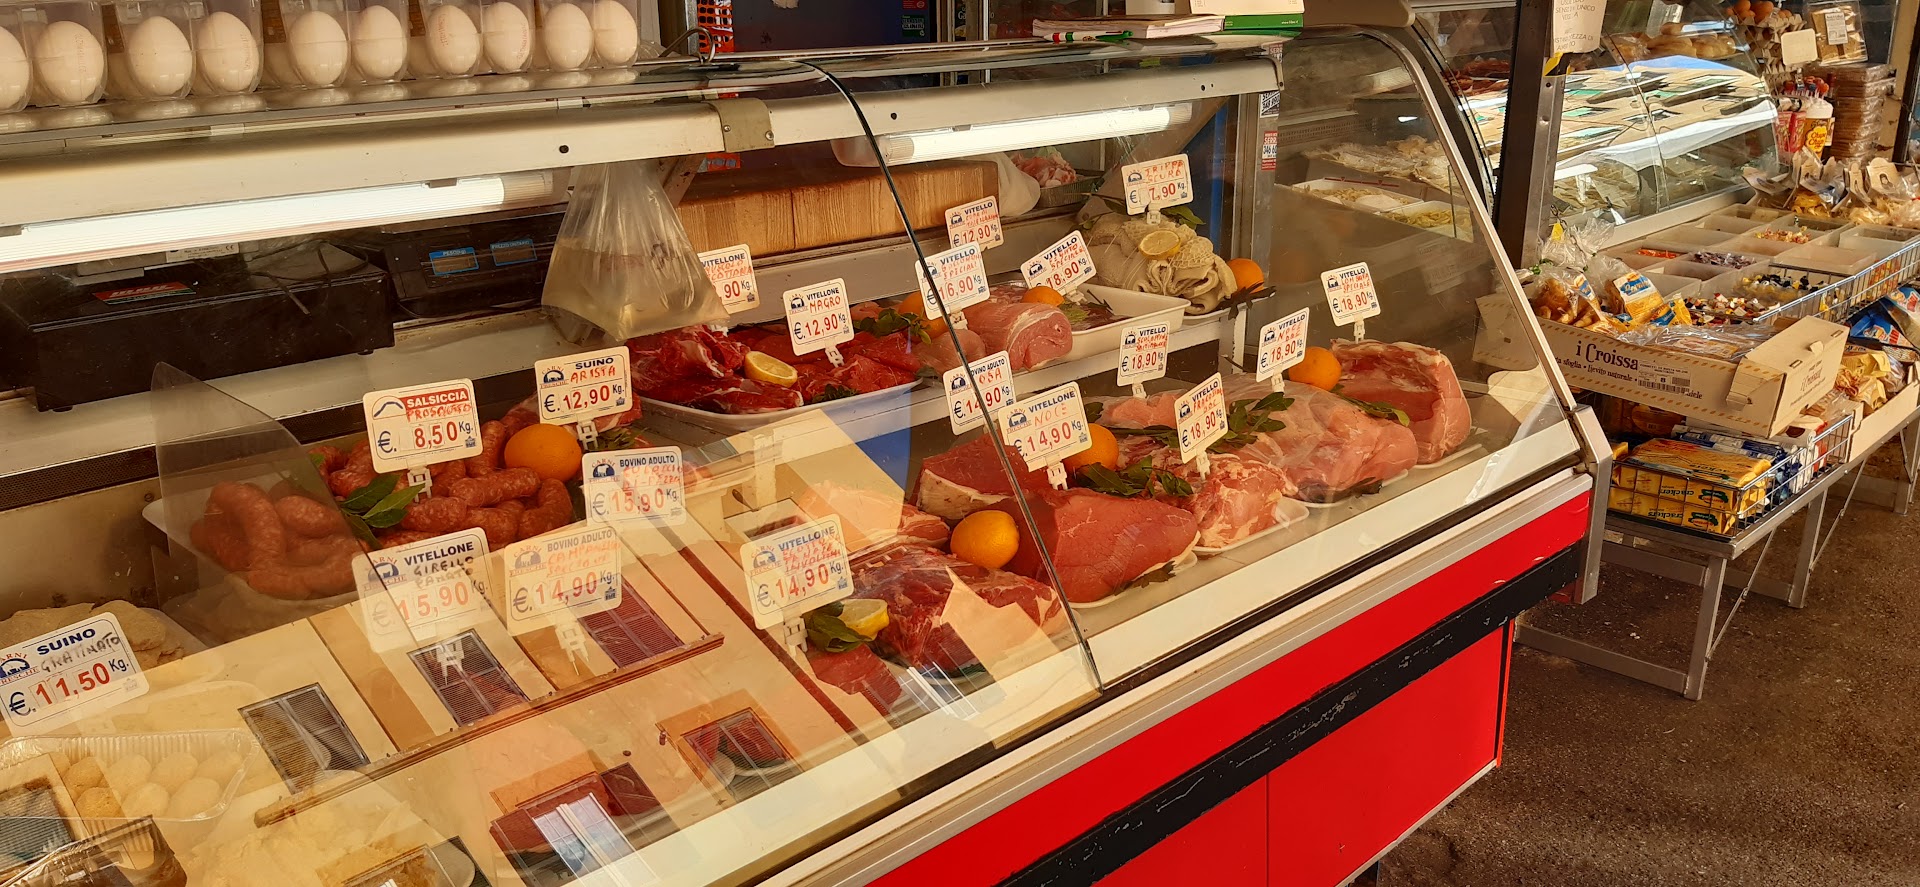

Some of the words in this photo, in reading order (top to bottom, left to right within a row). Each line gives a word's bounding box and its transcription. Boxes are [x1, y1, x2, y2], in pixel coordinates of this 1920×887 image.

[964, 201, 993, 215] VITELLO
[701, 253, 746, 268] VITELLONE
[940, 248, 976, 265] VITELLO
[1044, 237, 1078, 261] VITELLO
[1339, 268, 1366, 279] VITELLO
[806, 287, 840, 300] VITELLONE
[939, 275, 974, 300] 16,90
[809, 296, 841, 314] MAGRO
[1342, 291, 1368, 311] 18,90
[805, 313, 839, 337] 12,90
[1139, 326, 1166, 337] VITELLO
[1278, 314, 1306, 330] VITELLO
[1131, 351, 1157, 371] 18,90
[1270, 340, 1296, 363] 18,90
[570, 365, 616, 384] ARISTA
[575, 357, 614, 370] SUINO
[986, 358, 1005, 371] ADULTO
[1607, 369, 1633, 382] naturale
[406, 390, 468, 408] SALSICCIA
[563, 385, 610, 410] 12,90
[612, 384, 625, 395] Kg.
[1029, 390, 1076, 413] VITELLONE
[1192, 381, 1219, 403] VITELLO
[414, 421, 459, 449] 8,50
[458, 421, 474, 434] Kg.
[1027, 422, 1072, 452] 14,90
[1190, 411, 1217, 440] 18,90
[619, 457, 647, 468] BOVINO
[648, 455, 675, 465] ADULTO
[612, 488, 665, 514] 15,90
[547, 537, 579, 553] BOVINO
[581, 529, 613, 545] ADULTO
[778, 525, 836, 552] VITELLONE
[404, 541, 475, 566] VITELLONE
[536, 571, 597, 605] 14,90
[776, 563, 829, 598] 14,90
[397, 581, 470, 621] 15,90
[37, 628, 96, 656] SUINO
[36, 662, 111, 705] 11,50
[108, 658, 129, 673] Kg.
